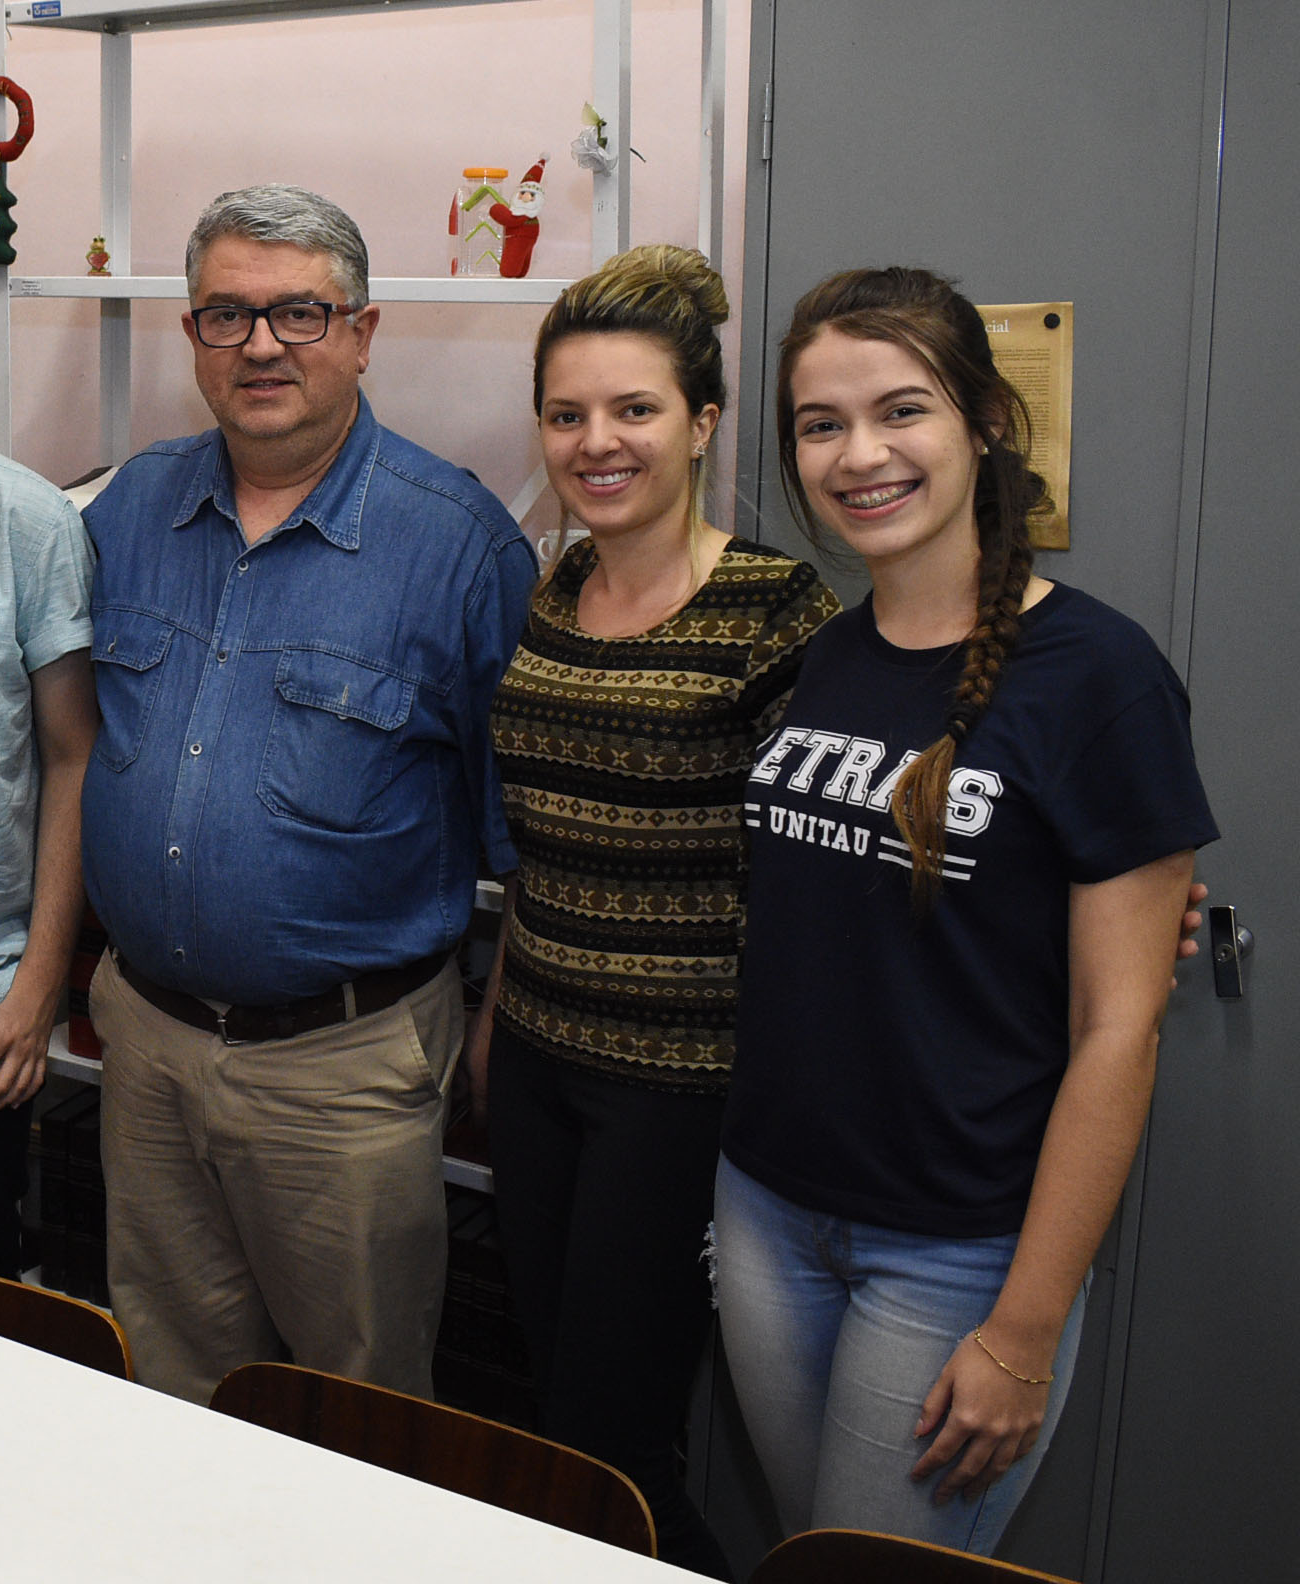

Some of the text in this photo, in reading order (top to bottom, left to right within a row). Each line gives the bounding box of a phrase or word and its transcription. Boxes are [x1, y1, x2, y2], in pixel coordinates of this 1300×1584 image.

[983, 319, 1010, 333] cial
[748, 726, 1004, 837] ETRS
[769, 805, 871, 857] UNITAU
